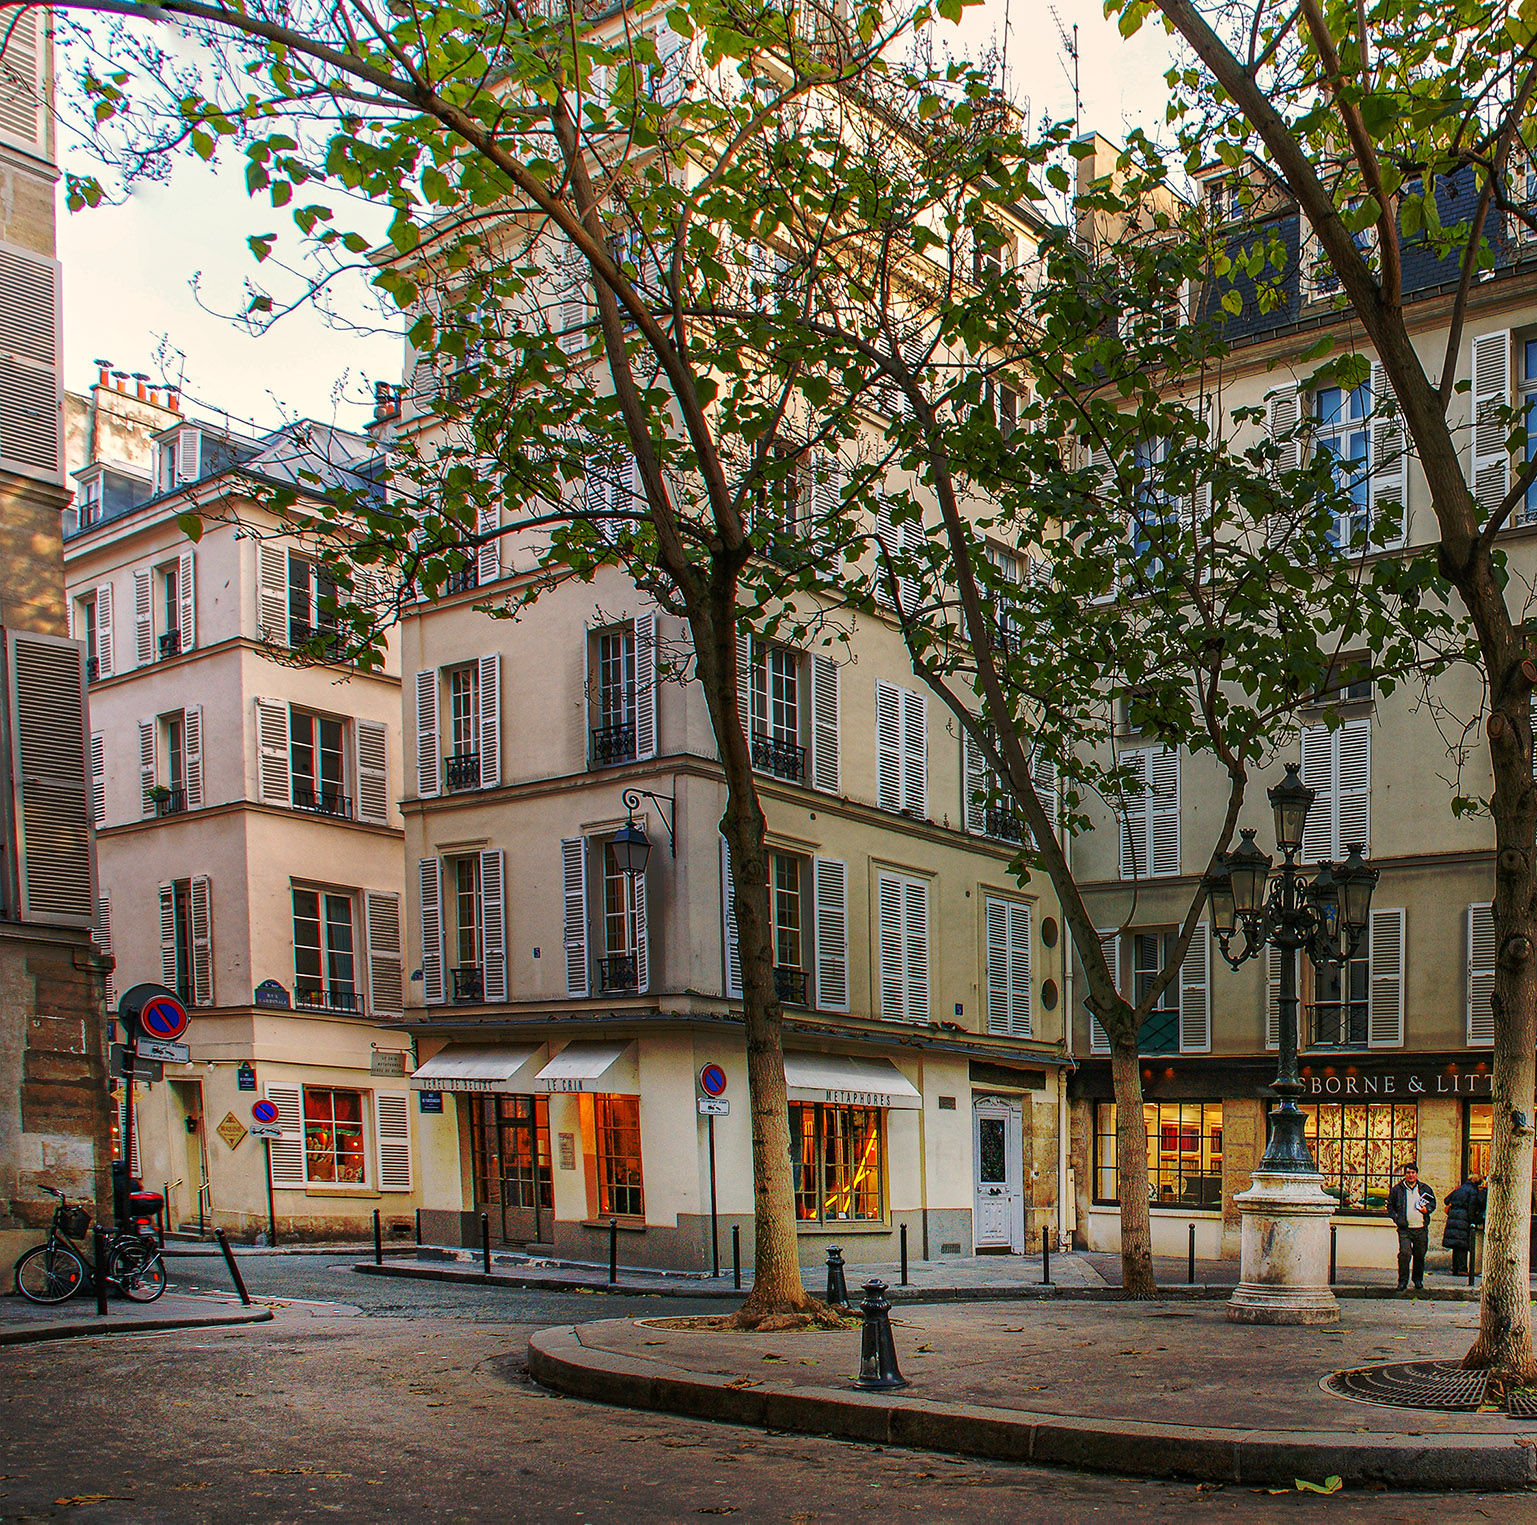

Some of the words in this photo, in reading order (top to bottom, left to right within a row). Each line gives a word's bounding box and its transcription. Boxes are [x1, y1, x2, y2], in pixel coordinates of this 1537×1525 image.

[547, 1079, 557, 1091] LE
[1298, 1075, 1396, 1095] SBORNE
[1408, 1075, 1427, 1094] &
[1437, 1074, 1494, 1093] LITT
[826, 1090, 891, 1106] METAPHORES
